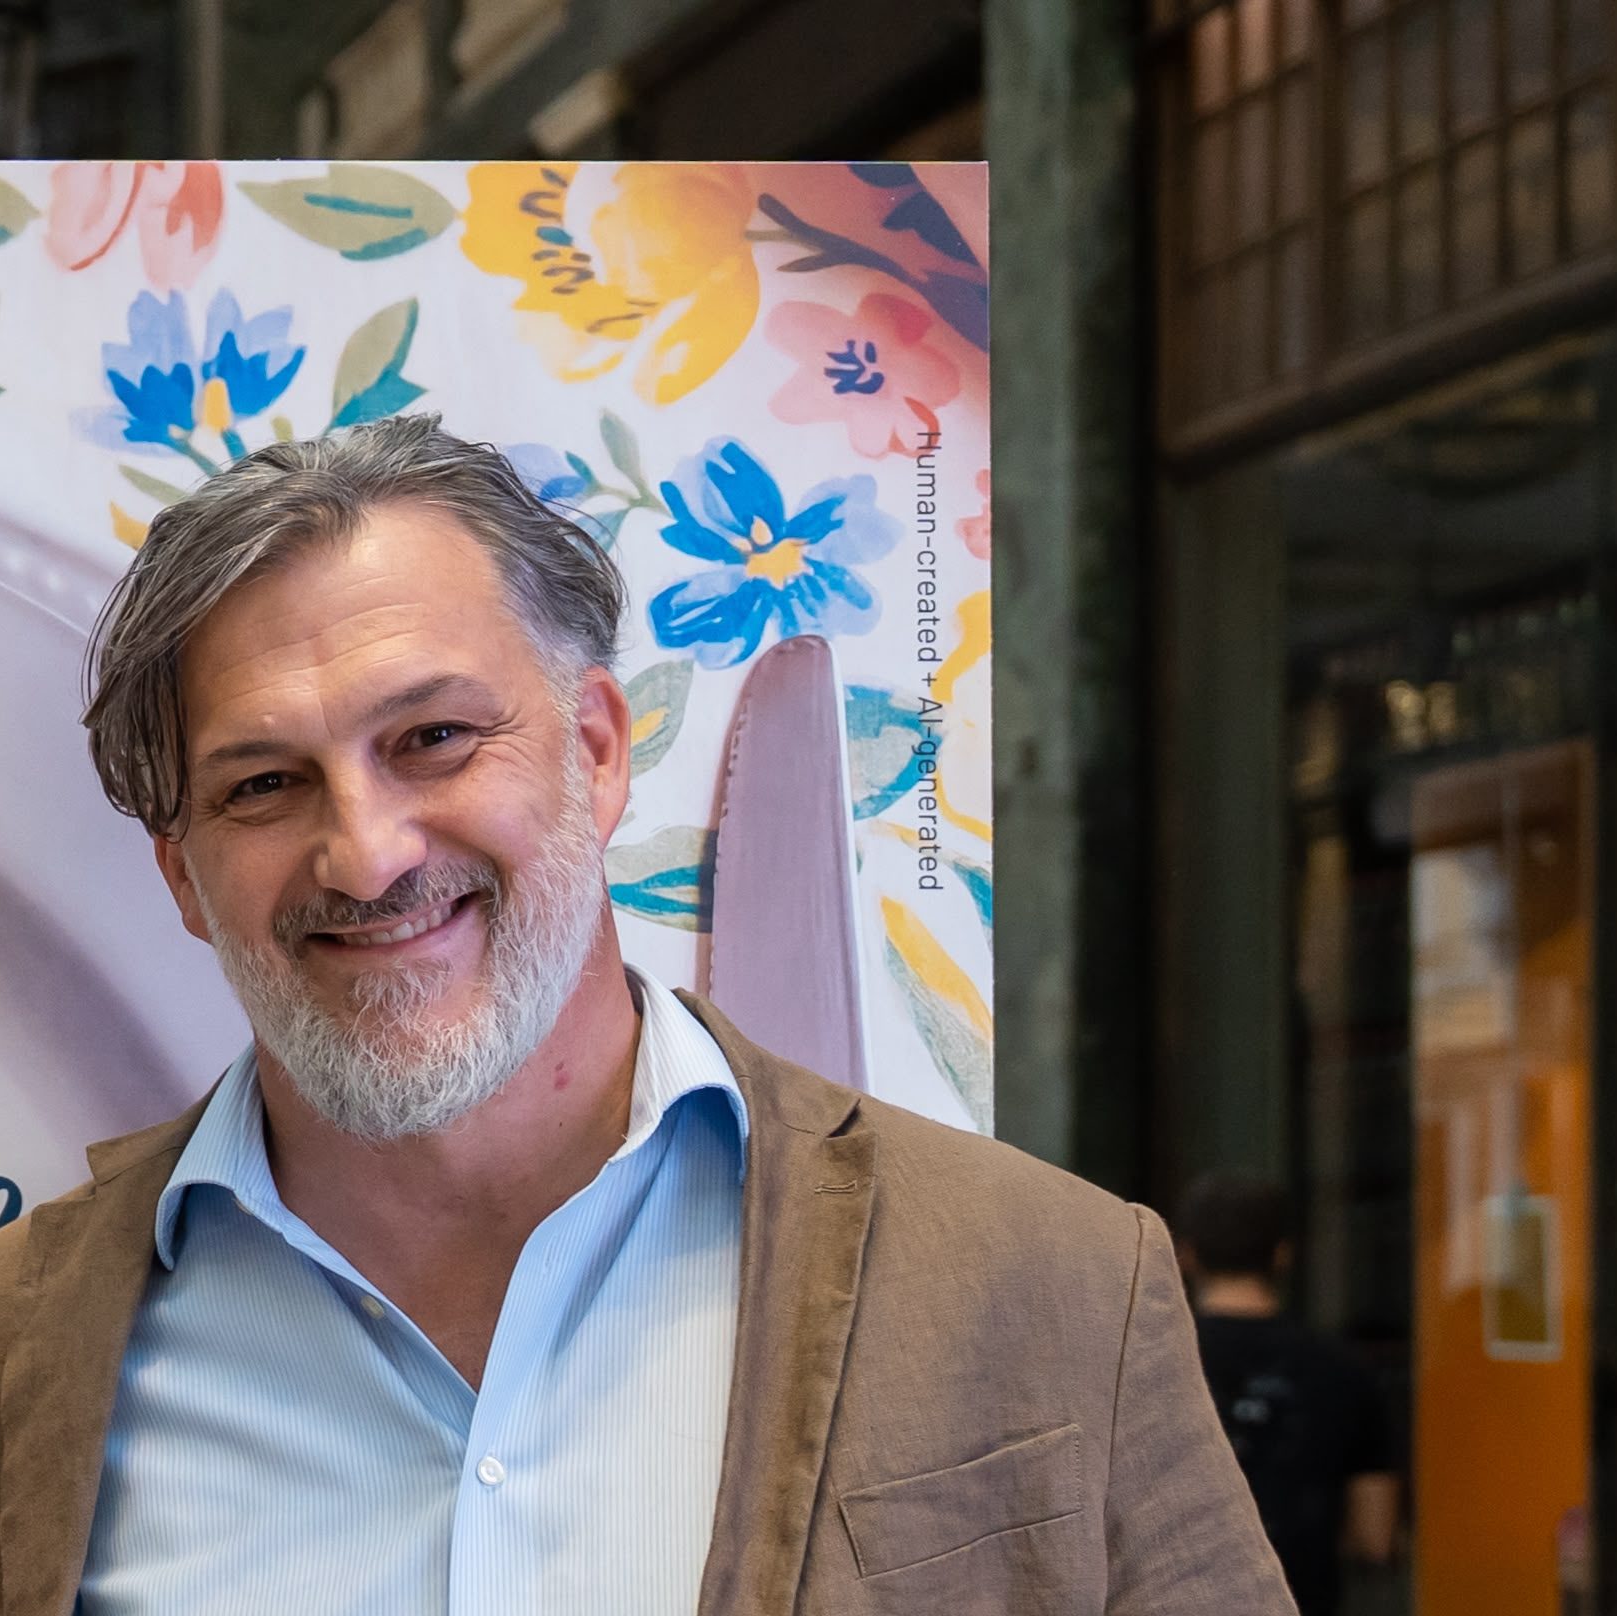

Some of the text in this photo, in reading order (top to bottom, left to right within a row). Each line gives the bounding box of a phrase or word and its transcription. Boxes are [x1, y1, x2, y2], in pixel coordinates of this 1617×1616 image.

[911, 431, 943, 890] Human-created + AI-generated
